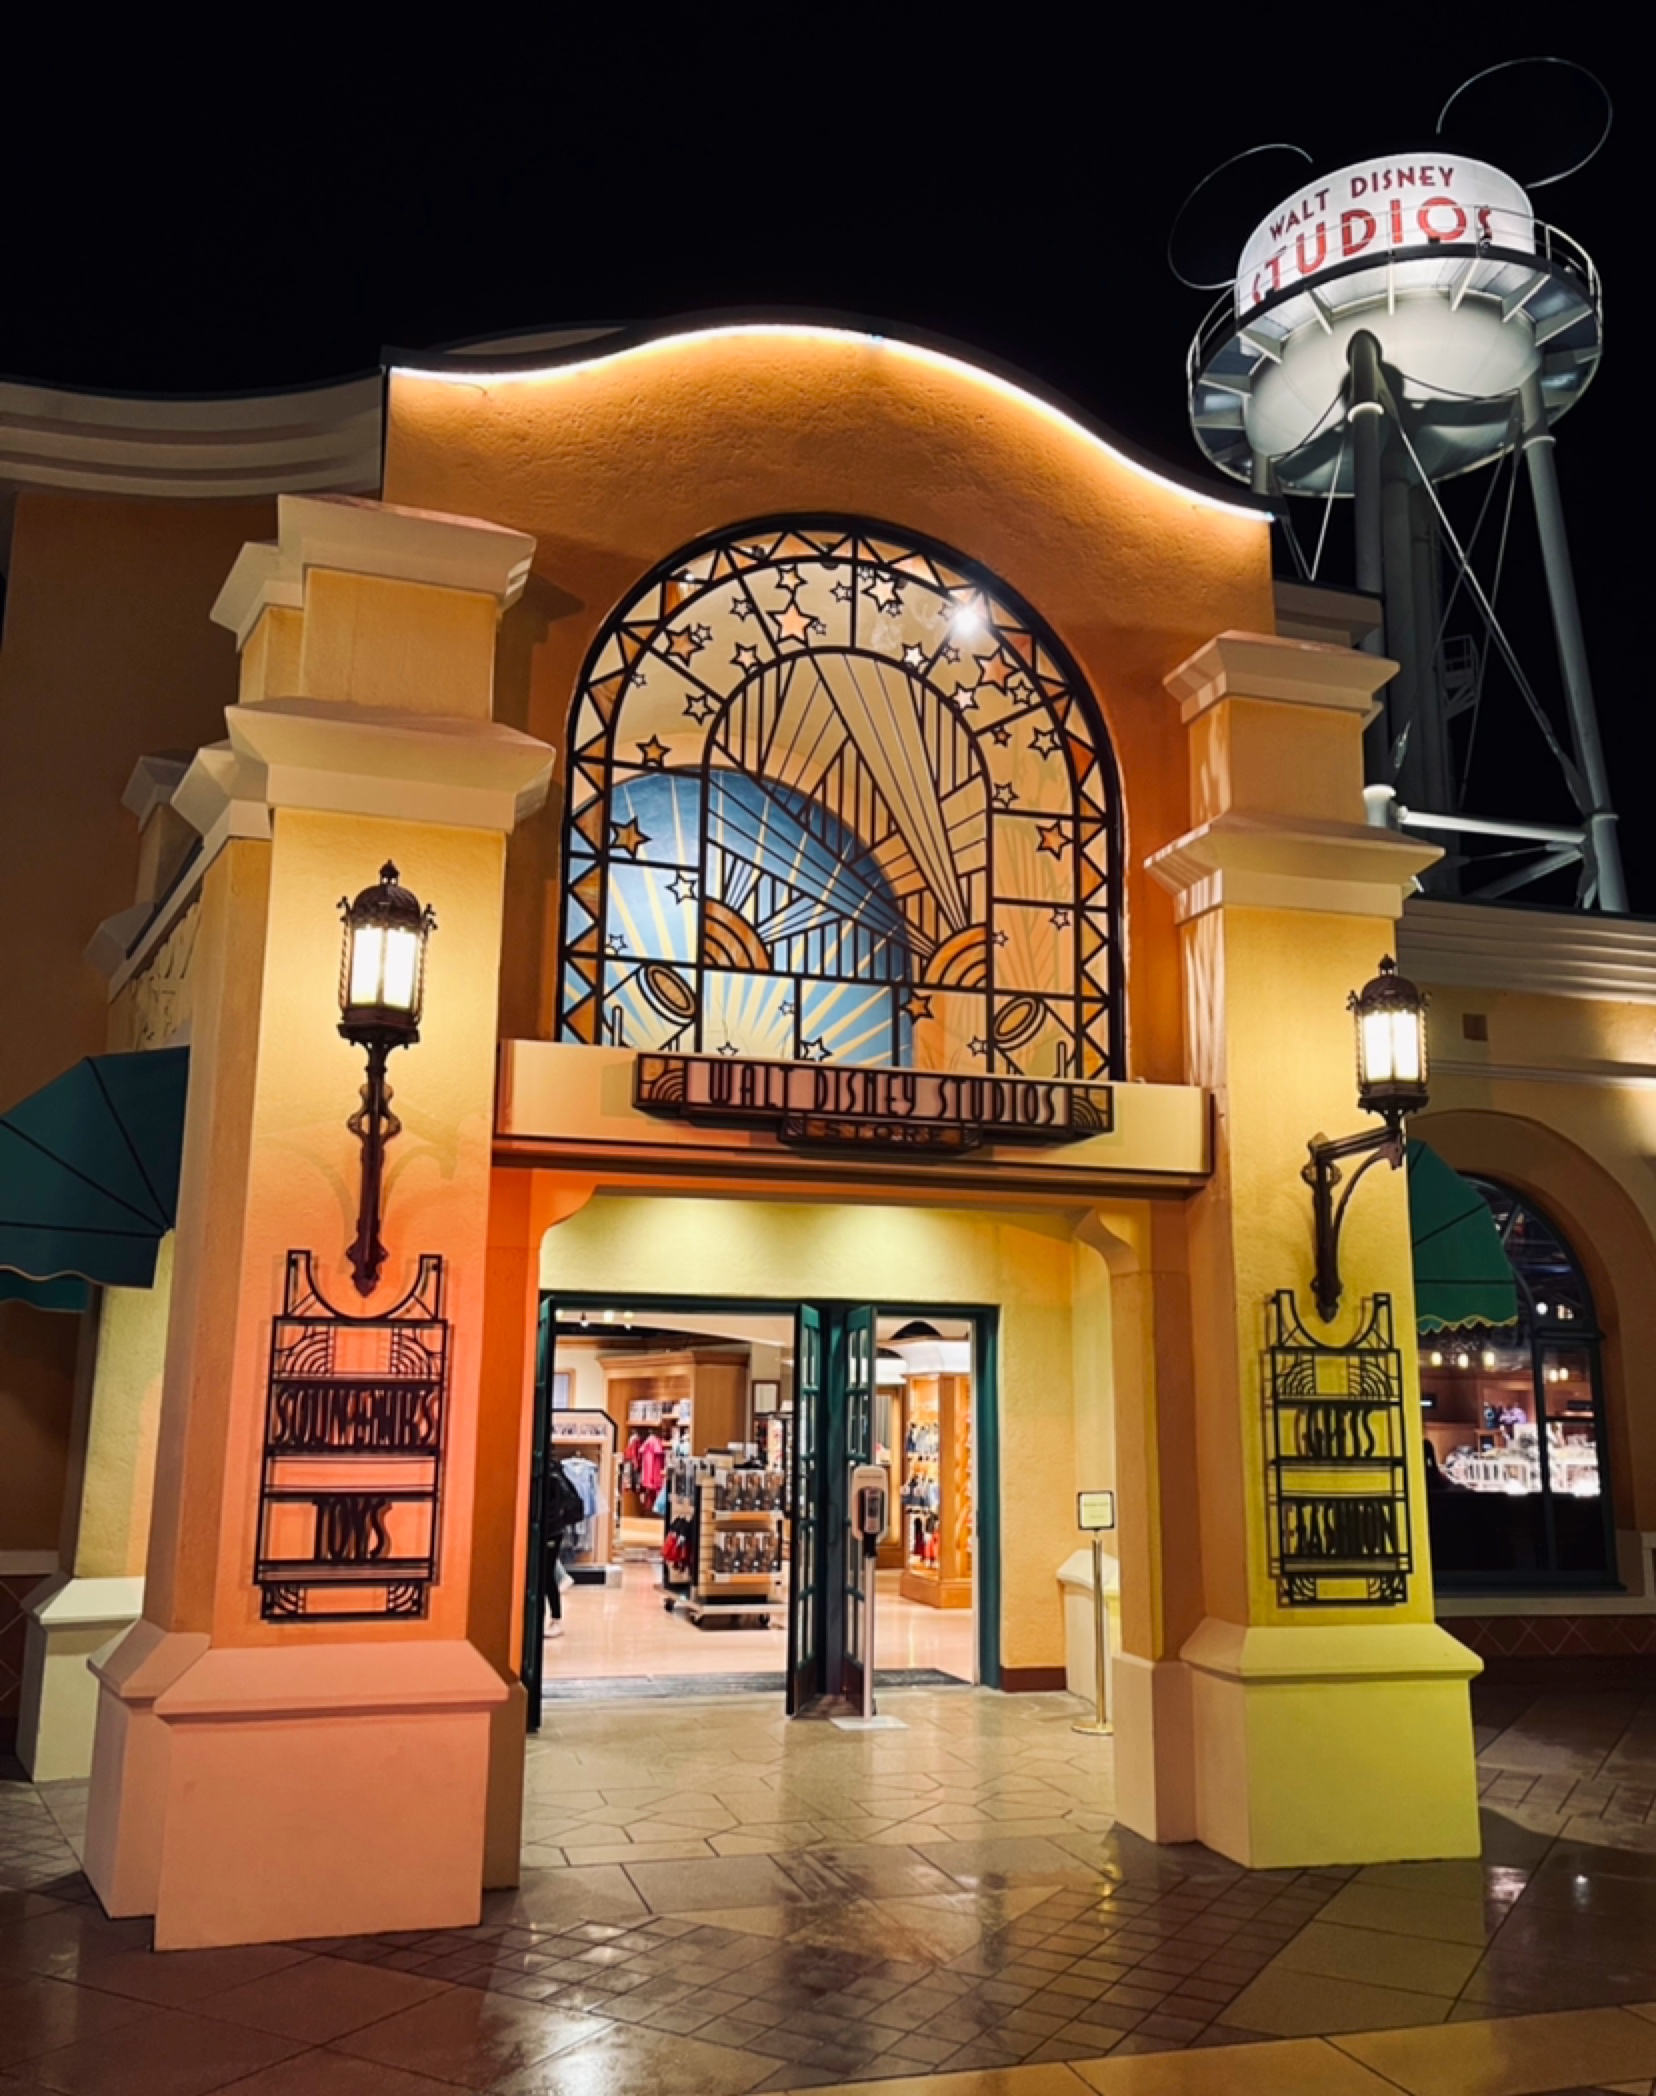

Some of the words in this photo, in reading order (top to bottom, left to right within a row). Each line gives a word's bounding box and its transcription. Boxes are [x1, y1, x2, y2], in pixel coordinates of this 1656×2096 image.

[1269, 188, 1330, 241] WALT
[1350, 165, 1454, 199] DISNEY
[709, 1061, 794, 1110] WALT
[814, 1068, 917, 1117] DISNEY
[938, 1076, 1056, 1126] STUDIOS
